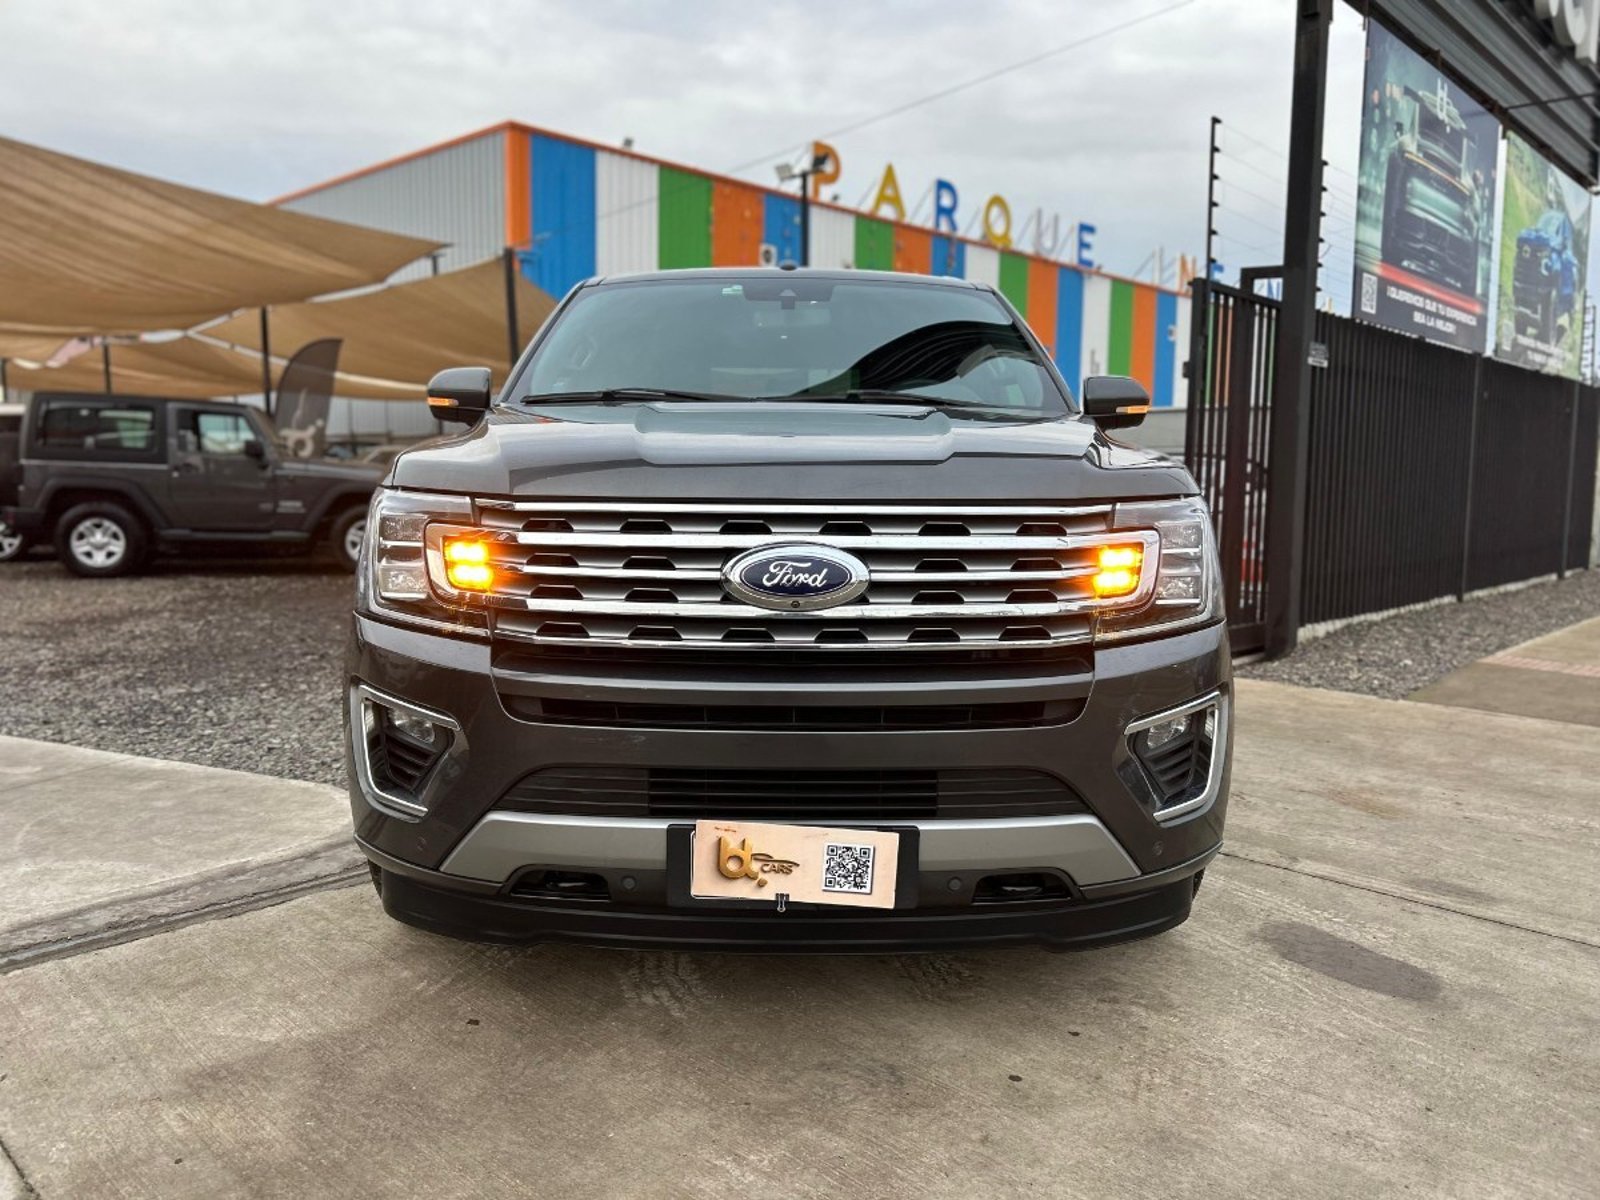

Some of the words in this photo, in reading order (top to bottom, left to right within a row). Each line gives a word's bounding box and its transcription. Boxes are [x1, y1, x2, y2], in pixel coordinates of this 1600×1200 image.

[811, 140, 1097, 268] PARQUE
[762, 560, 828, 588] Ford
[761, 863, 794, 875] CARS
